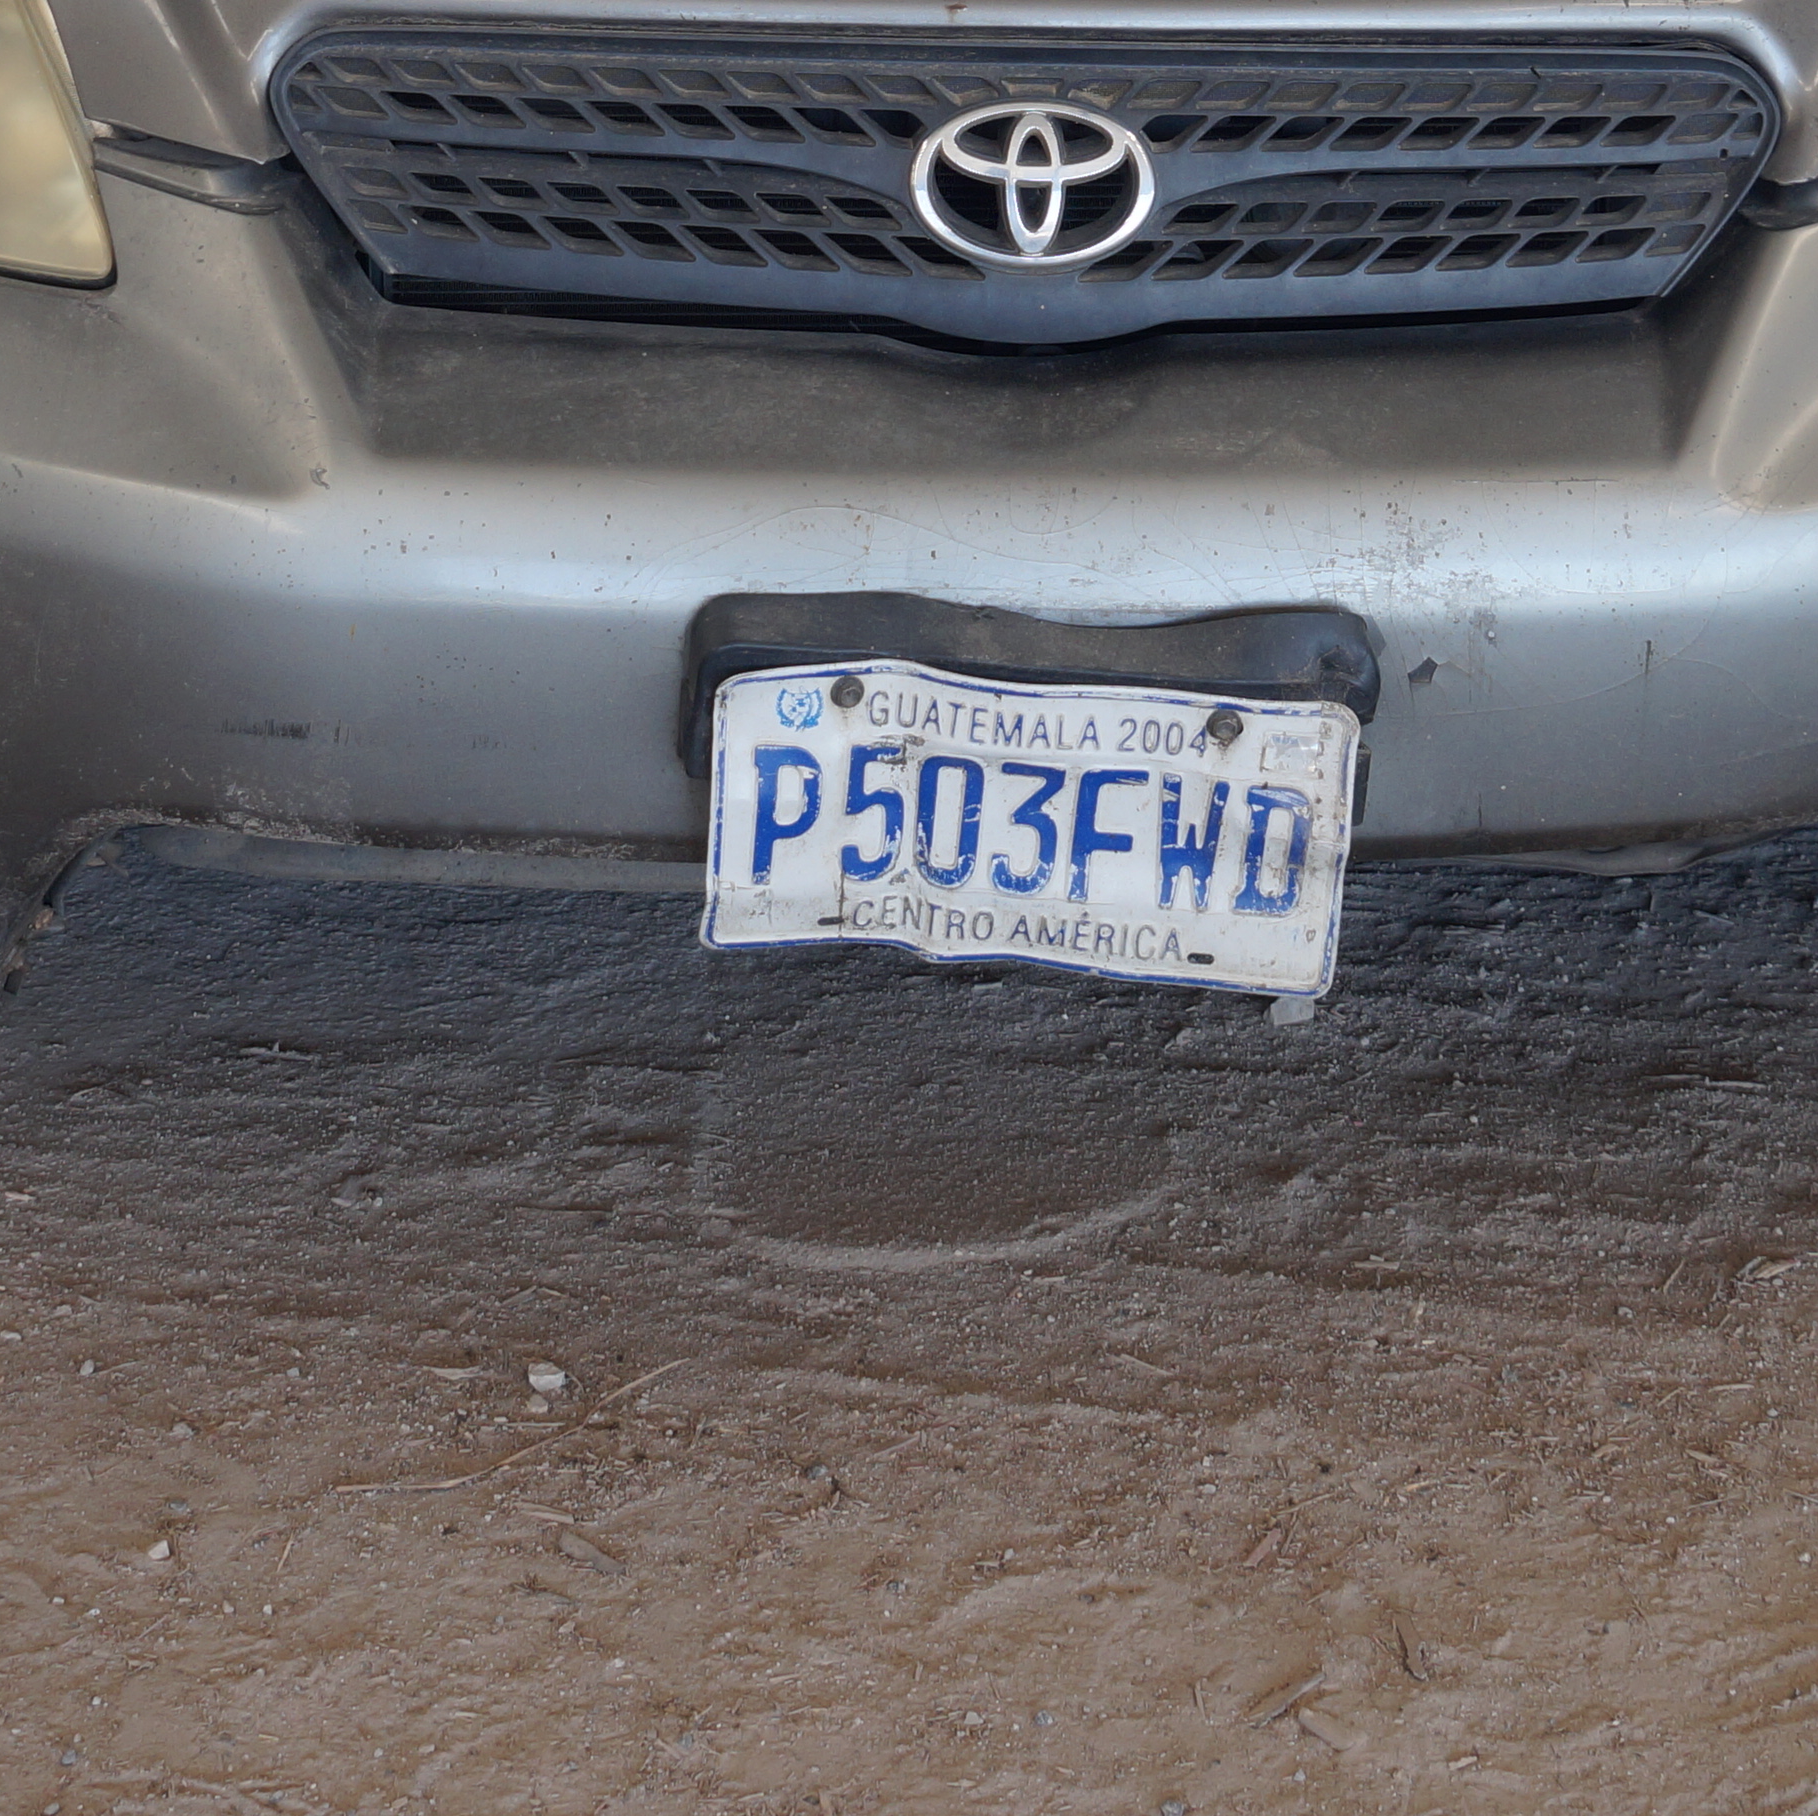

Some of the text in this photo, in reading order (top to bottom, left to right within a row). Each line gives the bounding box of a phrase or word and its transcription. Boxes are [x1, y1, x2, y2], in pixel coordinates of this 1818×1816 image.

[866, 690, 1208, 758] GUATEMALA 2004
[751, 744, 1315, 917] P503FWD
[852, 898, 1184, 964] CENTRO AMÉRICA
